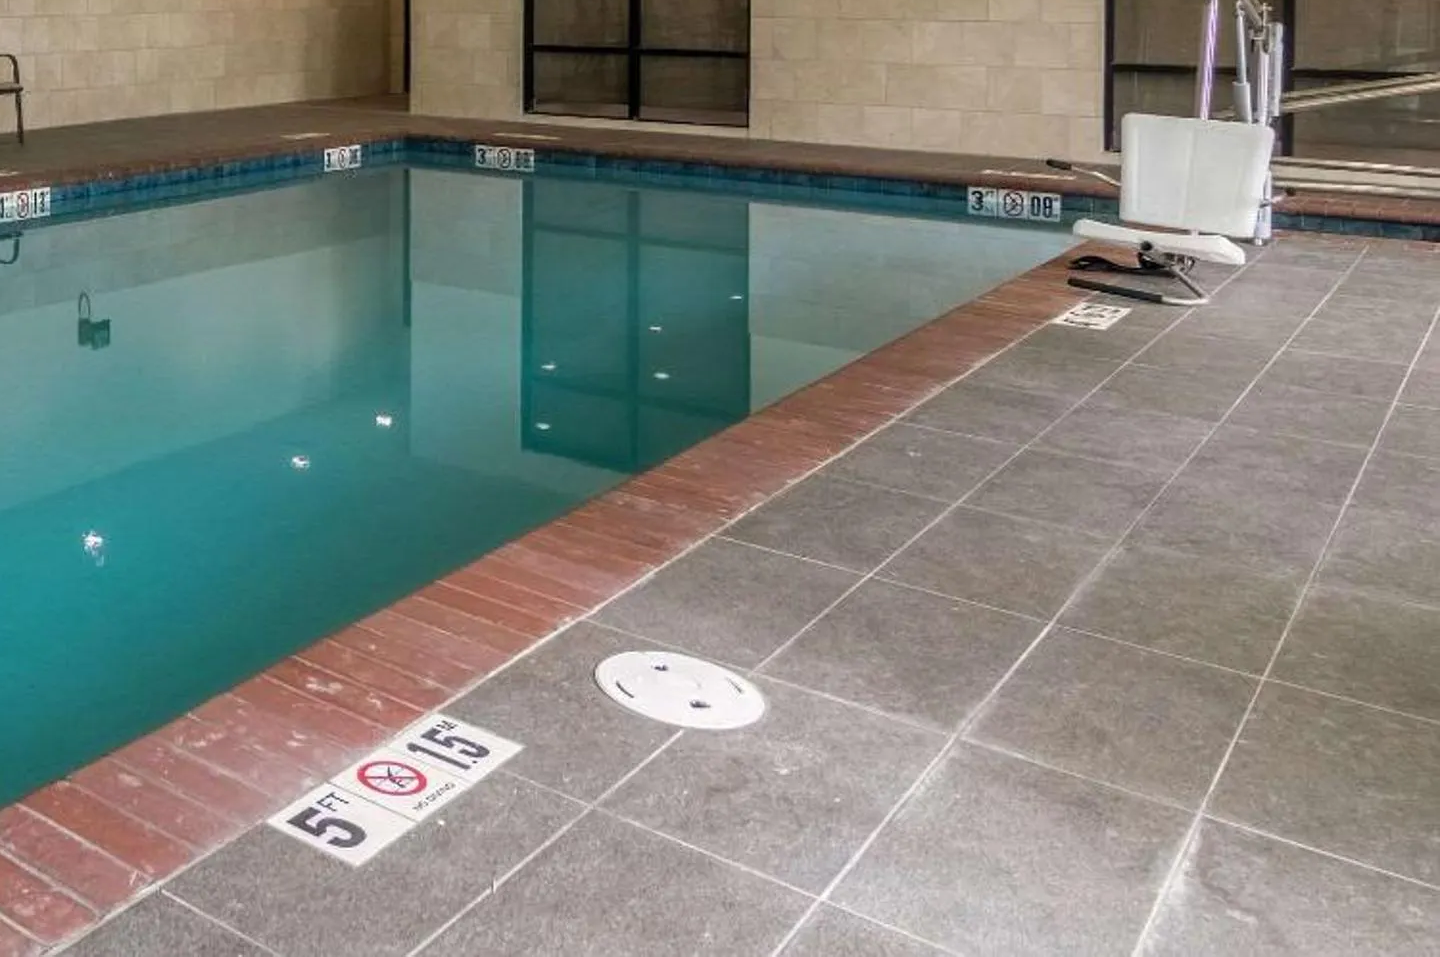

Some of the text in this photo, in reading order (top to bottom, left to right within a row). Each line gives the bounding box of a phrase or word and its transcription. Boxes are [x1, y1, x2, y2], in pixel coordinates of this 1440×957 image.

[971, 190, 984, 212] 3
[286, 792, 368, 848] 5 FT
